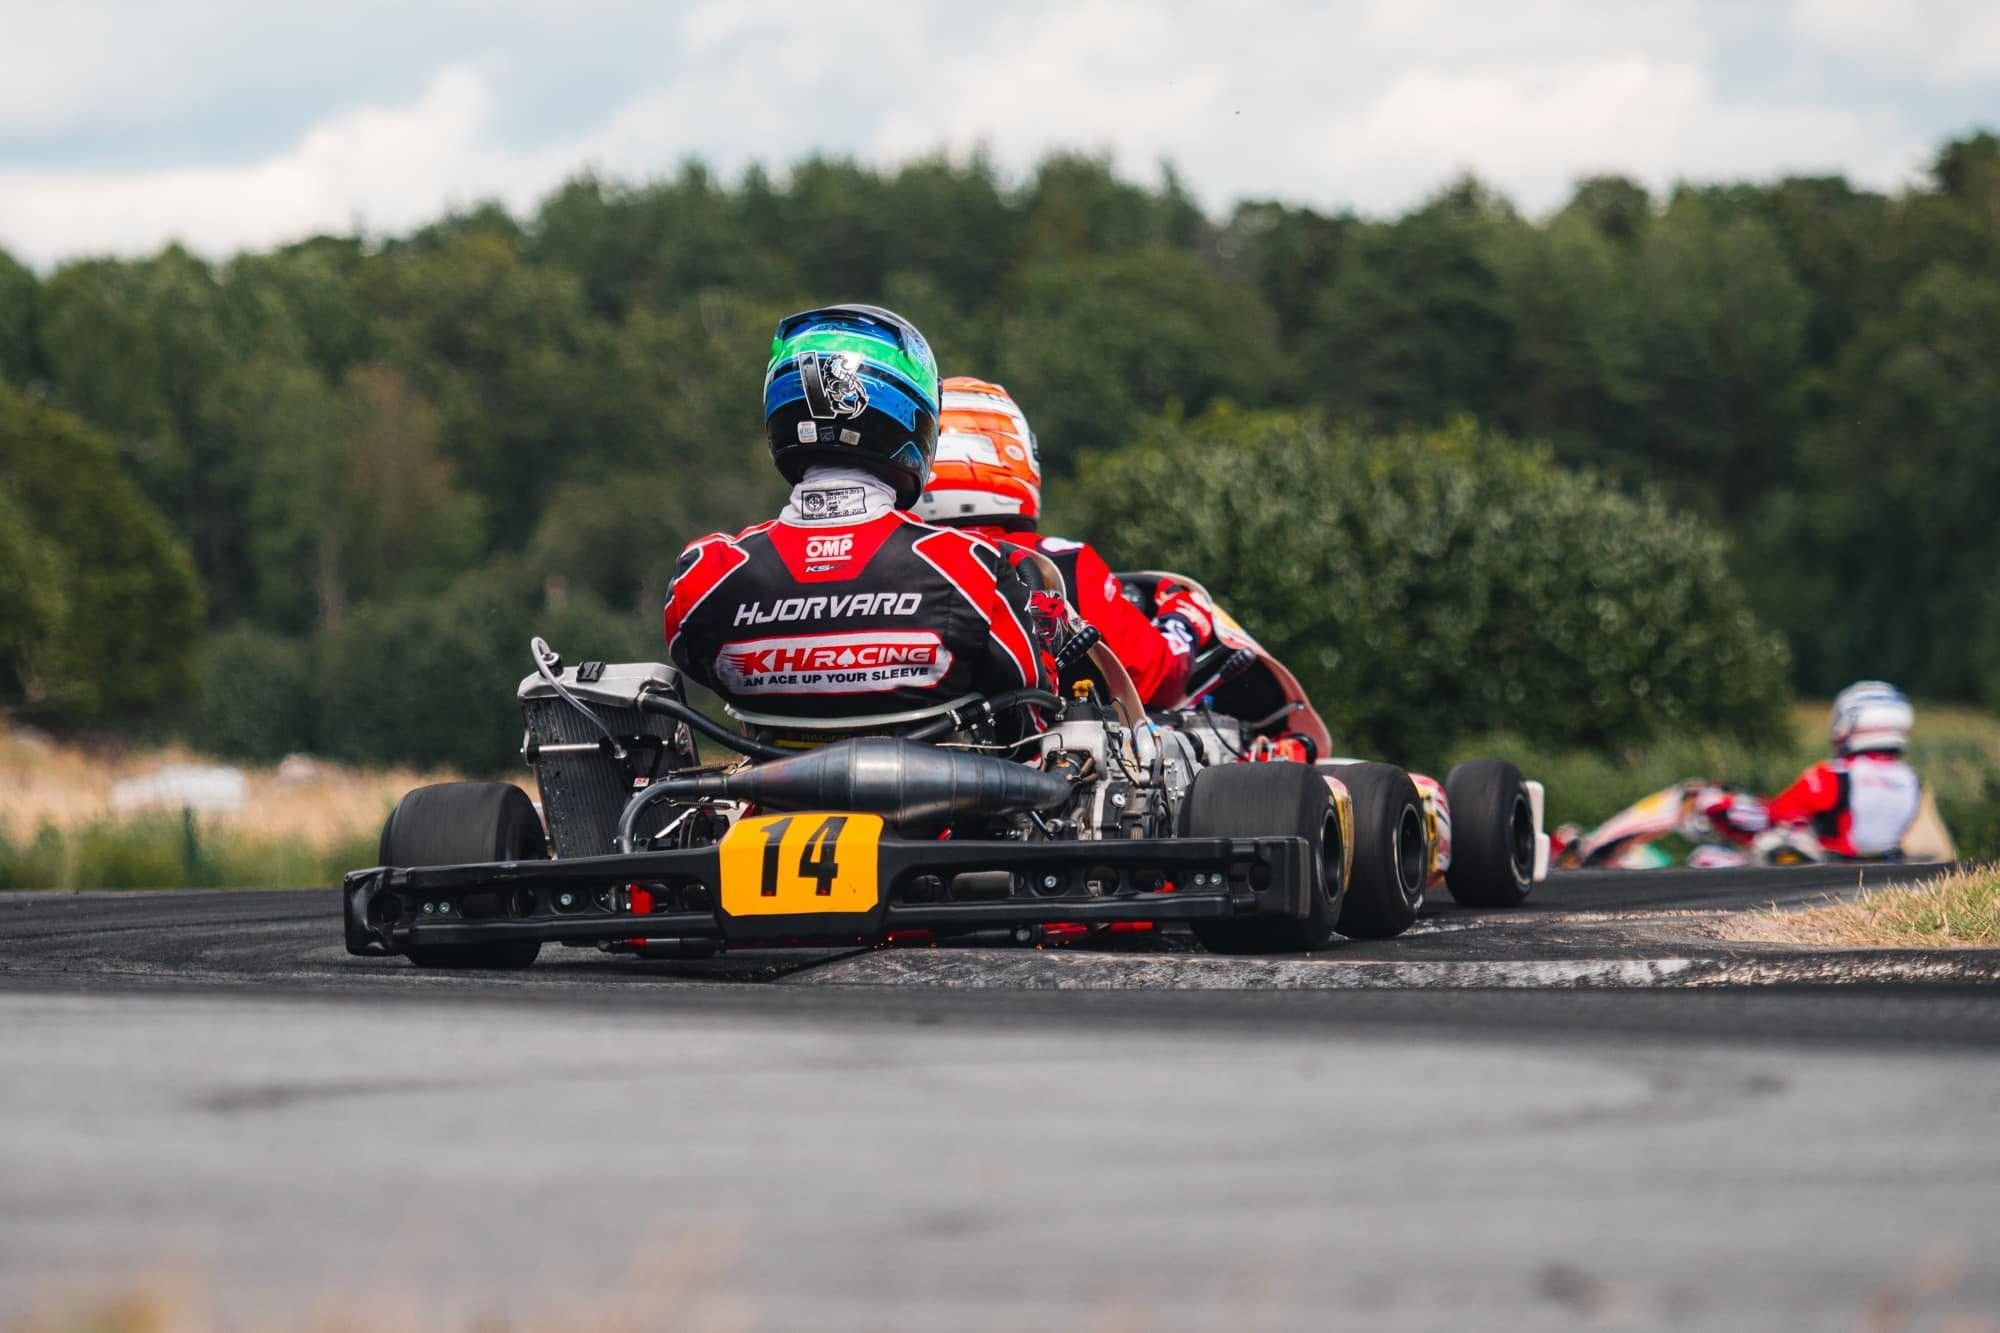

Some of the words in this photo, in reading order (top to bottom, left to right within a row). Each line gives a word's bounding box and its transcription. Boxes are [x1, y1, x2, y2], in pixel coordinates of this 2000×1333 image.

[805, 538, 854, 558] OMP
[733, 592, 922, 626] HJORVARD
[744, 677, 764, 687] AN
[768, 674, 797, 685] ACE
[801, 673, 822, 684] UP
[826, 672, 867, 683] YOUR
[871, 667, 929, 681] SLEEVE
[760, 816, 848, 897] 14
